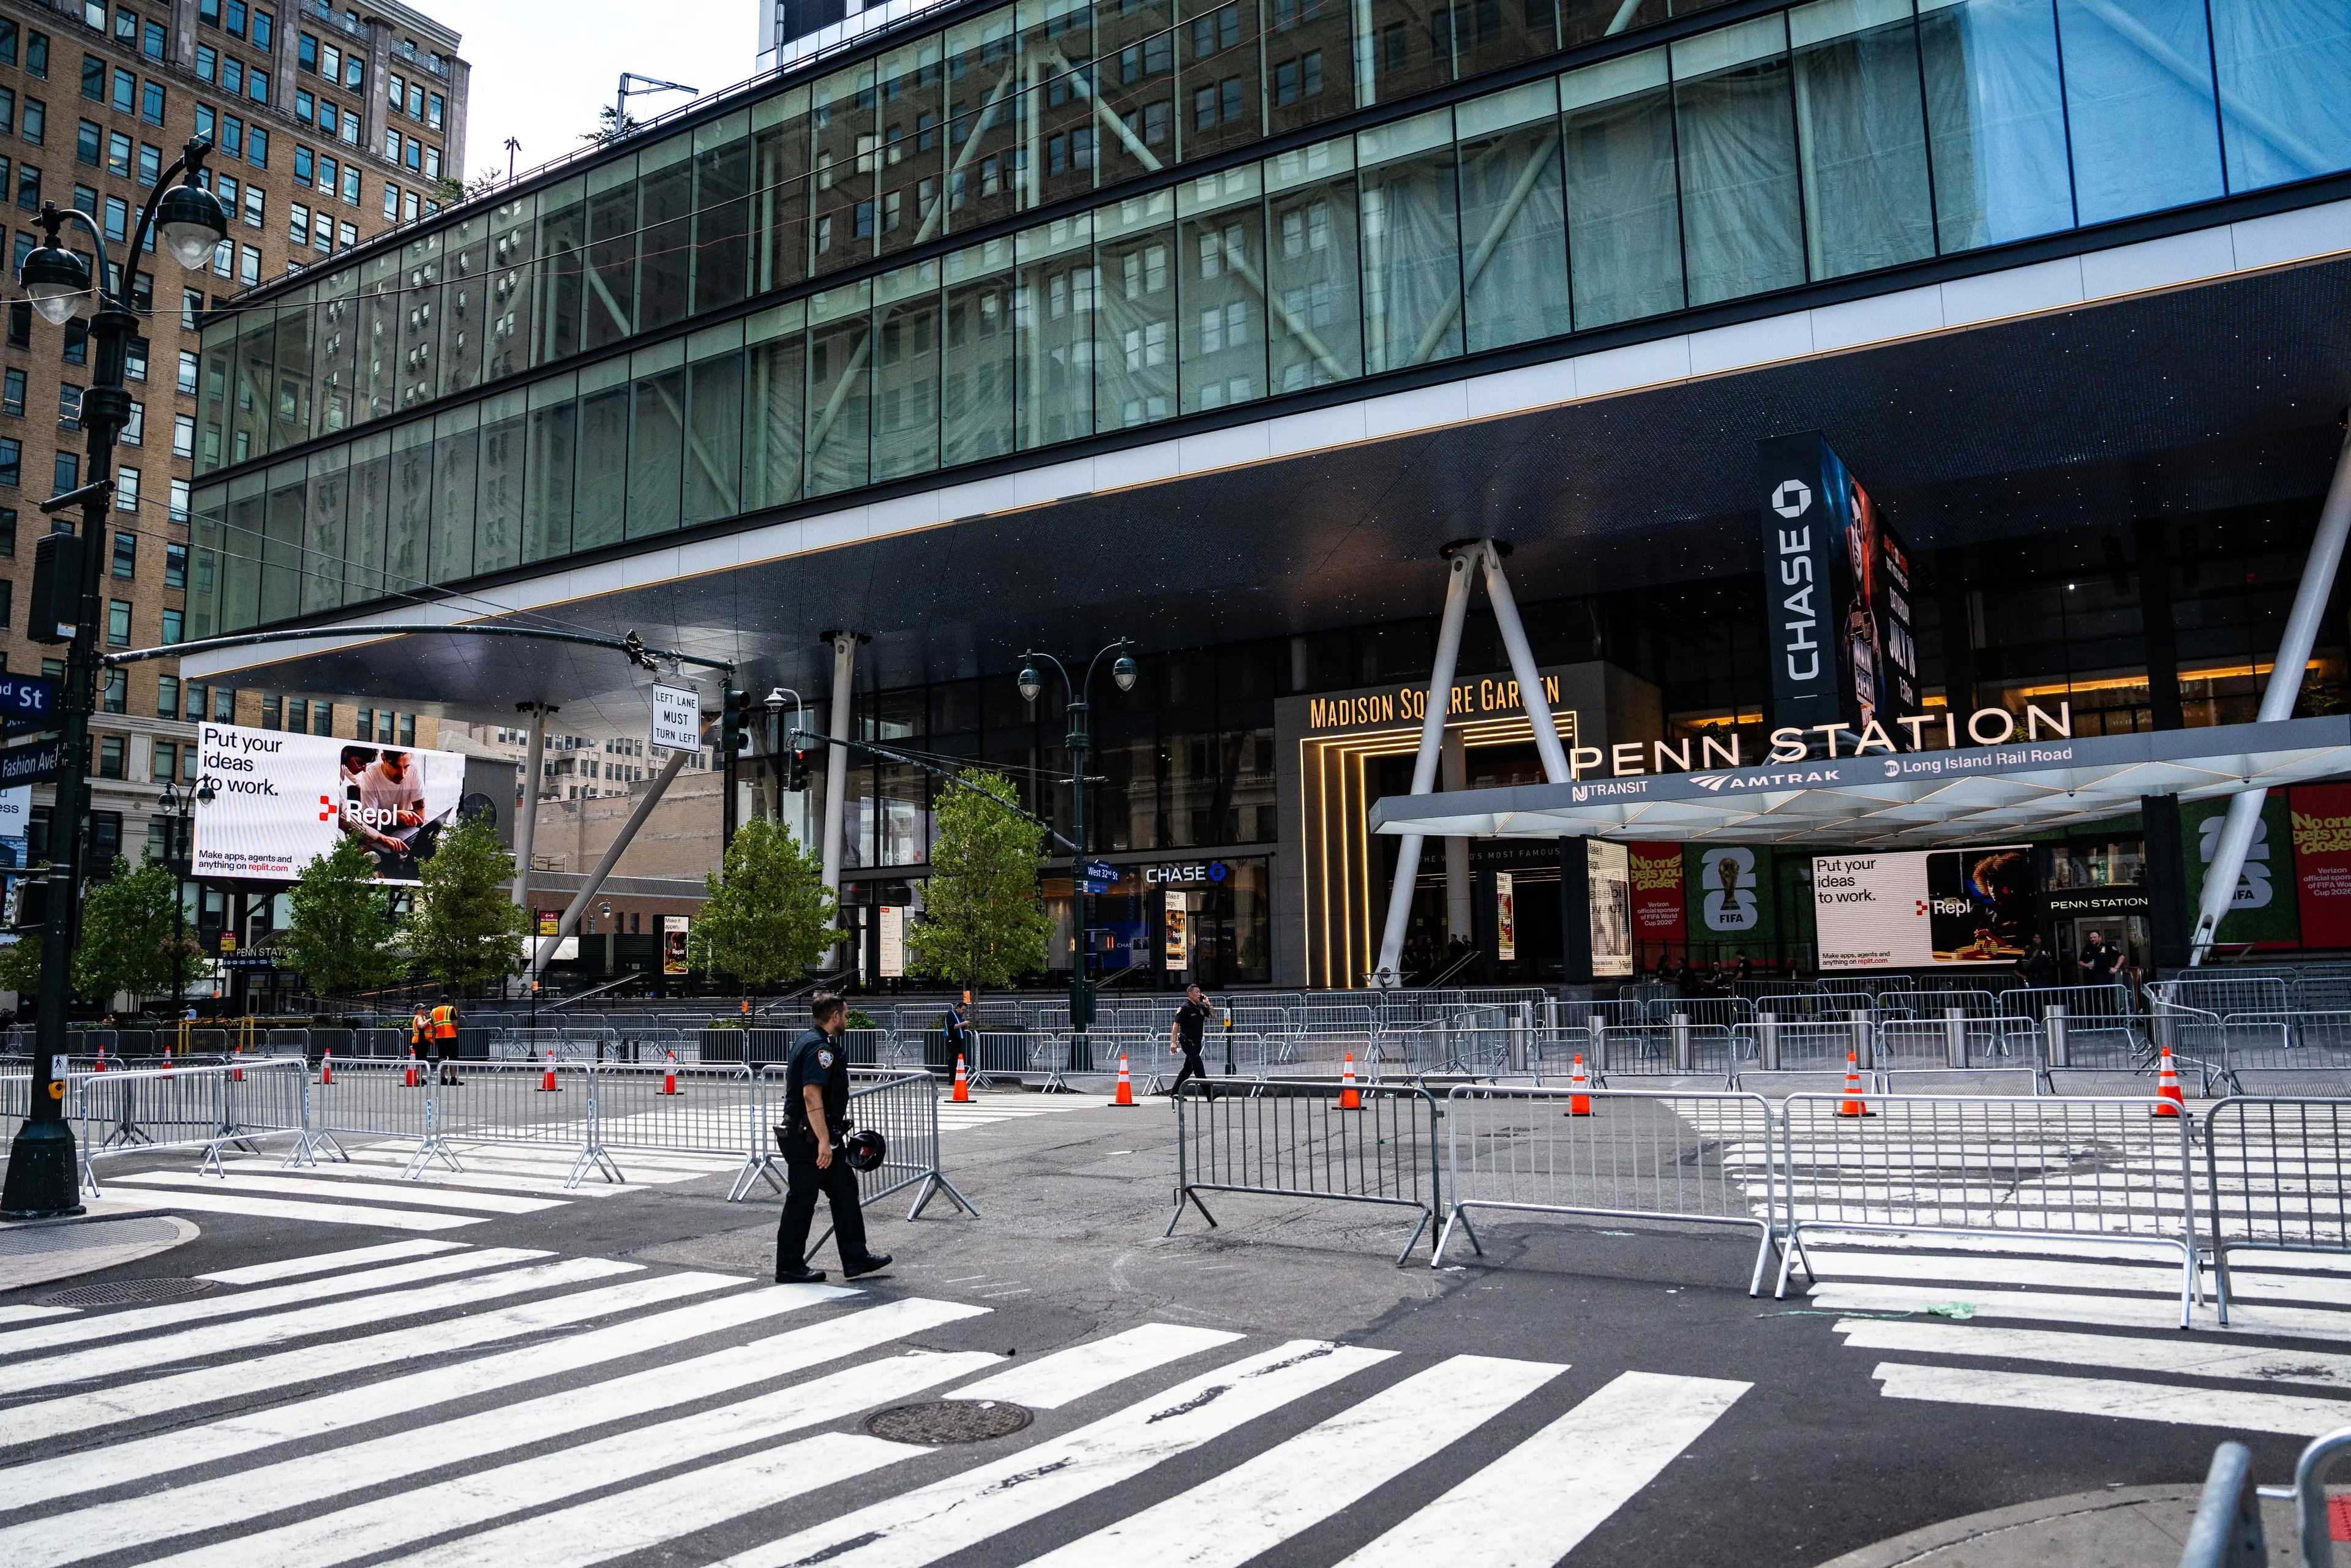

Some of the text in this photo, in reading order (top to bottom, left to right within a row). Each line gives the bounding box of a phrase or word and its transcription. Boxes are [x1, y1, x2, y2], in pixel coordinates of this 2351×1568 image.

[1779, 525, 1819, 680] CHASE
[1853, 634, 1872, 677] MAIN
[1889, 617, 1916, 678] JULY 18
[1856, 666, 1873, 703] EVENT
[20, 686, 42, 709] St
[656, 692, 696, 708] LEFT LANE
[1310, 676, 1559, 729] MADISON SQRE GARN
[664, 710, 688, 726] MUST
[204, 727, 283, 754] Put your
[656, 728, 696, 744] TURN LEFT
[1570, 733, 1740, 780] PENN
[1769, 702, 2072, 763] STATION
[2, 752, 54, 778] Fashion Ave
[203, 751, 253, 772] ideas
[1884, 748, 2072, 774] MTA Long Island Rail Road
[206, 775, 279, 797] o work.
[1730, 770, 1841, 789] AMTRAK
[1572, 781, 1649, 802] NJ TRANSIT
[346, 799, 398, 831] Repl
[2291, 811, 2323, 829] No
[2292, 828, 2351, 844] gets yo
[1488, 850, 1514, 859] MOST
[1520, 848, 1560, 857] FAMOUS
[2301, 838, 2351, 855] close
[199, 850, 222, 859] Make
[225, 853, 247, 861] apps,
[248, 853, 276, 863] agents
[1630, 852, 1682, 869] No one
[199, 861, 234, 871] anything
[249, 863, 288, 872] replit.com
[1087, 866, 1118, 880] West 32nd St
[1146, 866, 1207, 883] CHASE
[1630, 867, 1682, 882] gets you
[1817, 859, 1877, 874] Put your
[1637, 877, 1679, 891] closer
[1817, 875, 1855, 888] ideas
[1818, 888, 1876, 903] to work.
[2051, 898, 2148, 909] PENN STATION
[2233, 890, 2255, 900] IFA
[1934, 898, 1970, 917] Repl
[1719, 913, 1744, 923] FIFA
[236, 948, 257, 957] PENN
